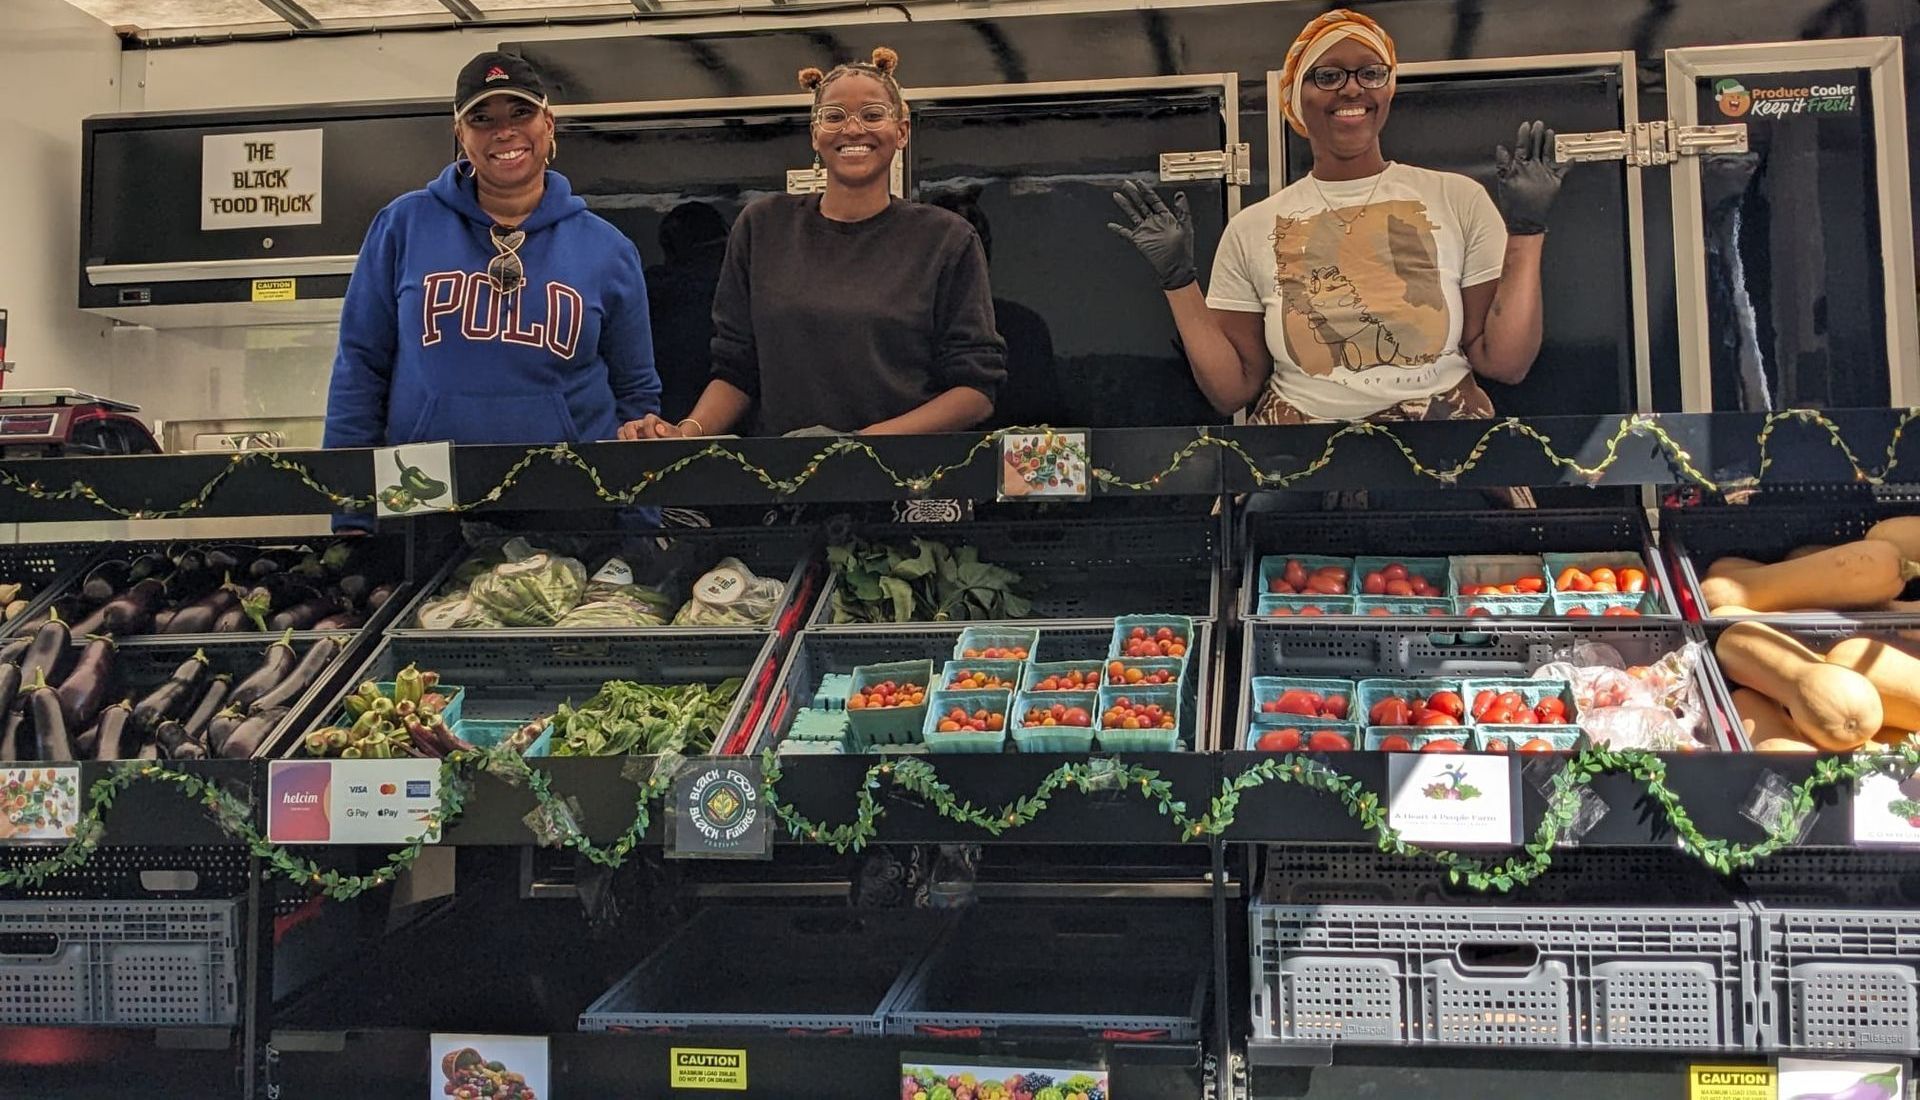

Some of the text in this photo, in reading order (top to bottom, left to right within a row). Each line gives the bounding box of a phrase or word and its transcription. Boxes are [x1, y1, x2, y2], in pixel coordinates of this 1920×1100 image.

[1752, 84, 1856, 99] Produce Cooler
[1751, 96, 1855, 119] Keep it Fresh!
[244, 142, 275, 162] THE
[232, 167, 291, 189] BLACK
[209, 193, 316, 217] FOOD TRUCK
[422, 270, 583, 360] POLO
[349, 786, 368, 794] VISA
[283, 791, 318, 804] helcim
[346, 808, 369, 818] G Pay
[384, 808, 398, 818] Pay
[680, 1055, 737, 1066] CAUTION
[1701, 1074, 1766, 1084] CAUTION
